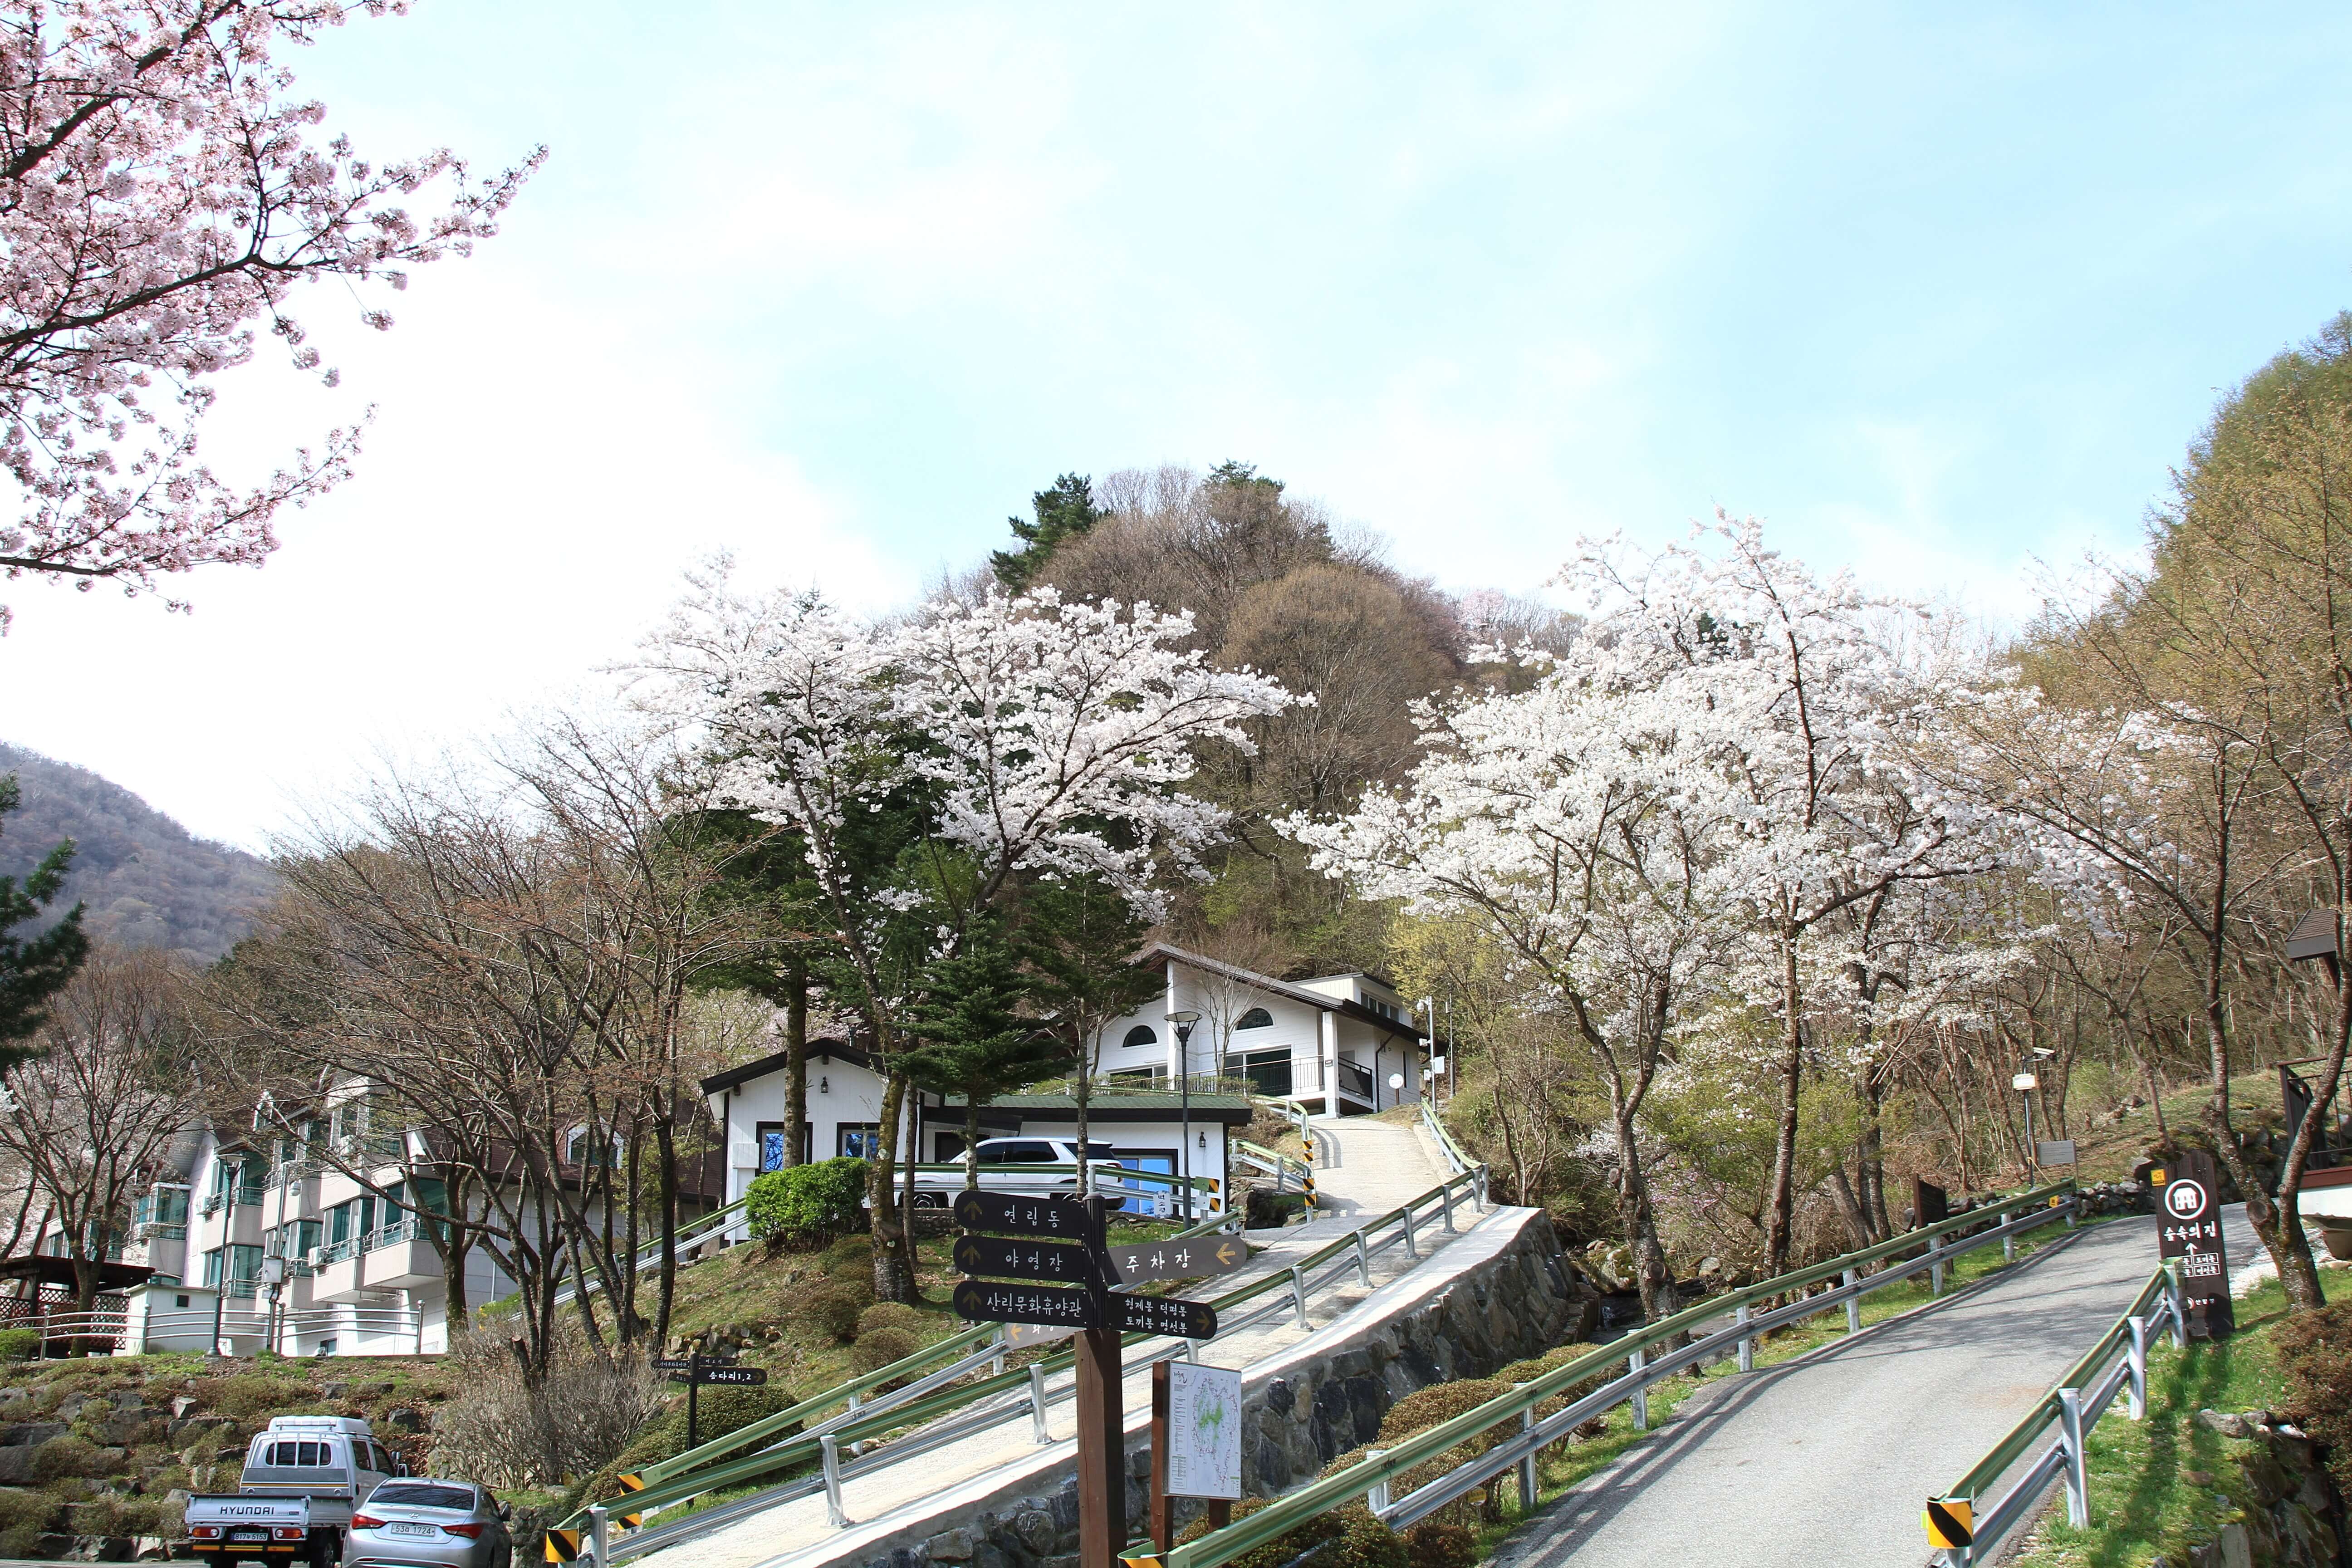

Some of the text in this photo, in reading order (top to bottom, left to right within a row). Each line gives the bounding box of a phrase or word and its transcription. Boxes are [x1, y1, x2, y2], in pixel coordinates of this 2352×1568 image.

[2164, 1220, 2216, 1242] 숲속의 집
[987, 1292, 1082, 1317] 산림문화휴양관
[1125, 1298, 1187, 1317] 형제봉 덕평봉
[1126, 1315, 1187, 1334] 토끼봉 명선봉
[220, 1506, 274, 1515] HYUNDAI
[413, 1526, 431, 1534] 1724
